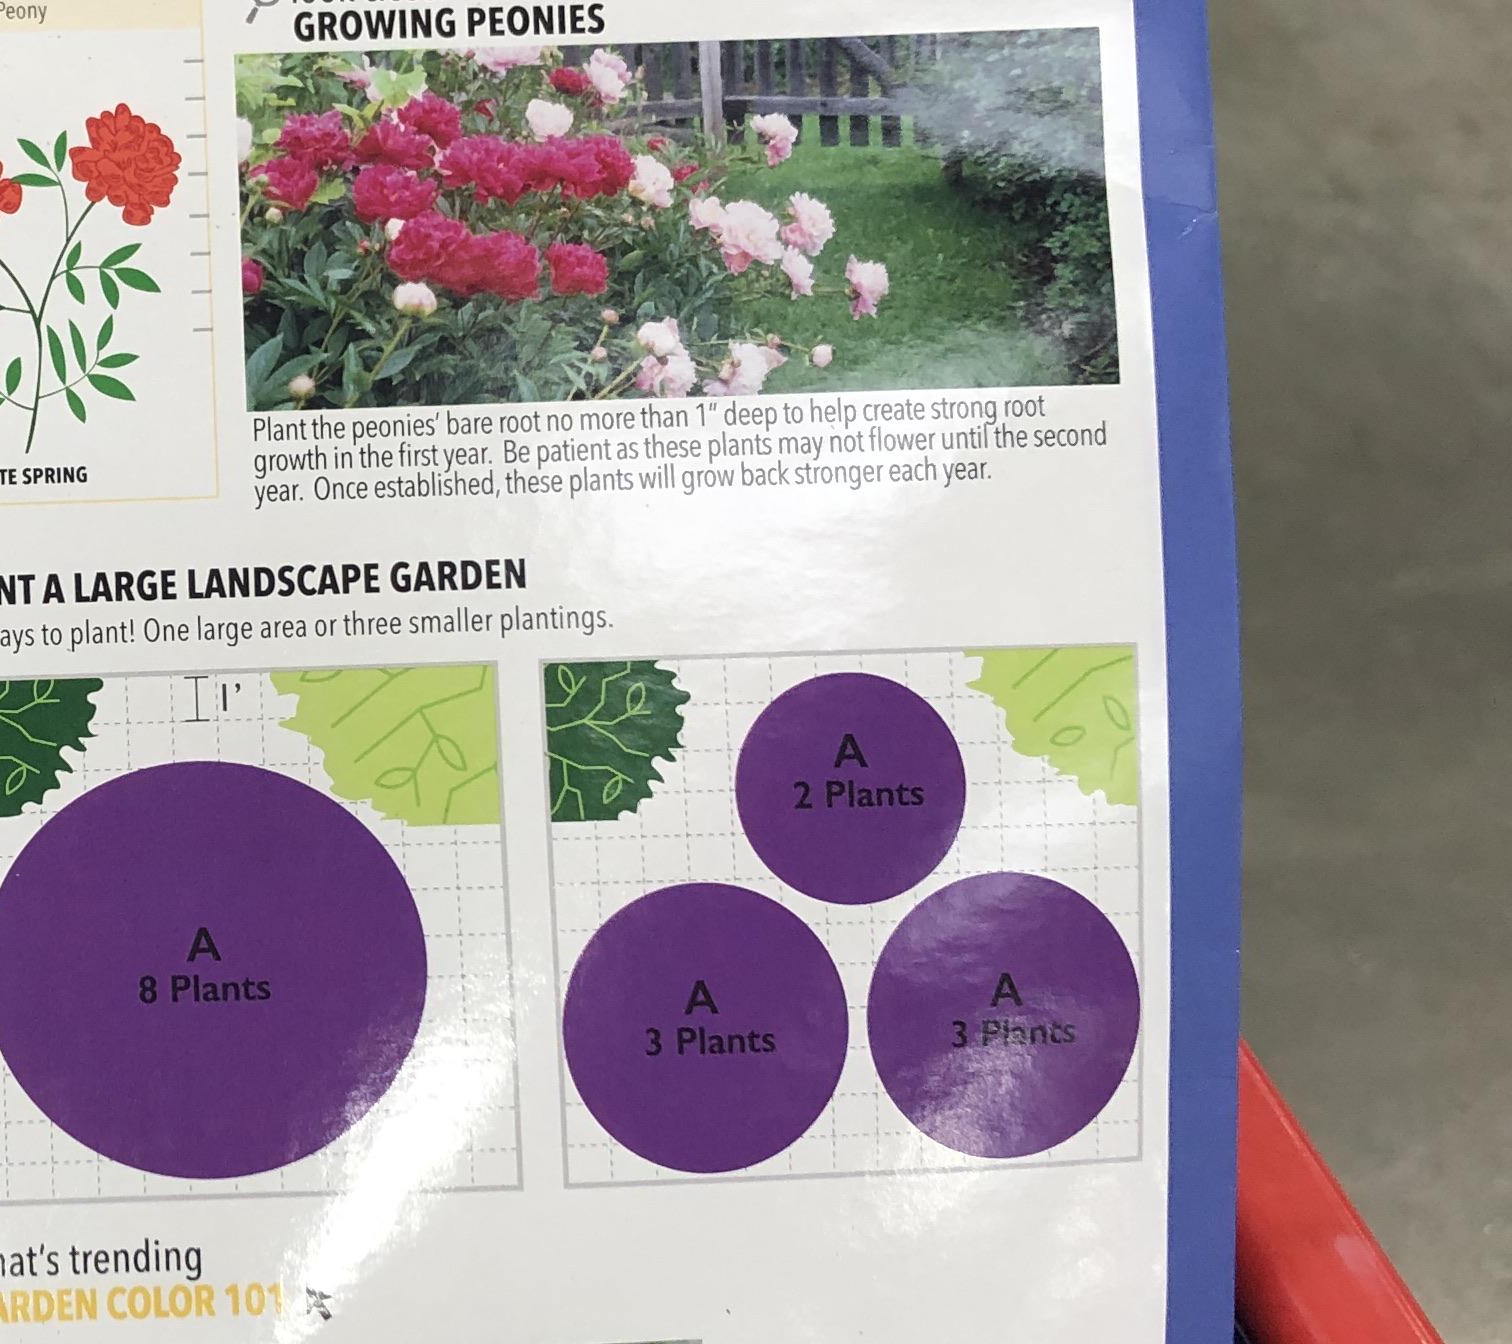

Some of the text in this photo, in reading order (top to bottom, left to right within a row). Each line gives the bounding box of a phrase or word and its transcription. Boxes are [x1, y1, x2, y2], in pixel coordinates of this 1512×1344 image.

[294, 3, 605, 42] GROWING PEONIES
[22, 466, 88, 485] SPRING
[254, 455, 992, 510] year. Once established, these plants will grow back stronger each year.
[42, 573, 66, 604] A
[74, 569, 178, 603] LARGE
[188, 562, 380, 600] LANDSCAPE
[390, 558, 526, 593] GARDEN
[41, 624, 62, 646] to
[70, 618, 135, 653] plant!
[144, 617, 190, 643] One
[197, 615, 253, 647] large
[260, 619, 307, 639] area
[314, 618, 338, 637] or
[342, 610, 402, 636] three
[409, 606, 493, 634] smaller
[500, 604, 614, 639] plantings.
[834, 733, 869, 768] A
[793, 780, 924, 810] 2 Plants
[186, 926, 222, 962] A
[139, 974, 271, 1004] 8 Plants
[684, 980, 719, 1016] A
[990, 972, 1024, 1008] A
[645, 1026, 776, 1056] 3 Plants
[951, 1018, 1076, 1049] 3 Plants
[68, 1238, 202, 1281] trending
[106, 1284, 216, 1320] COLOR
[225, 1282, 282, 1316] 101
